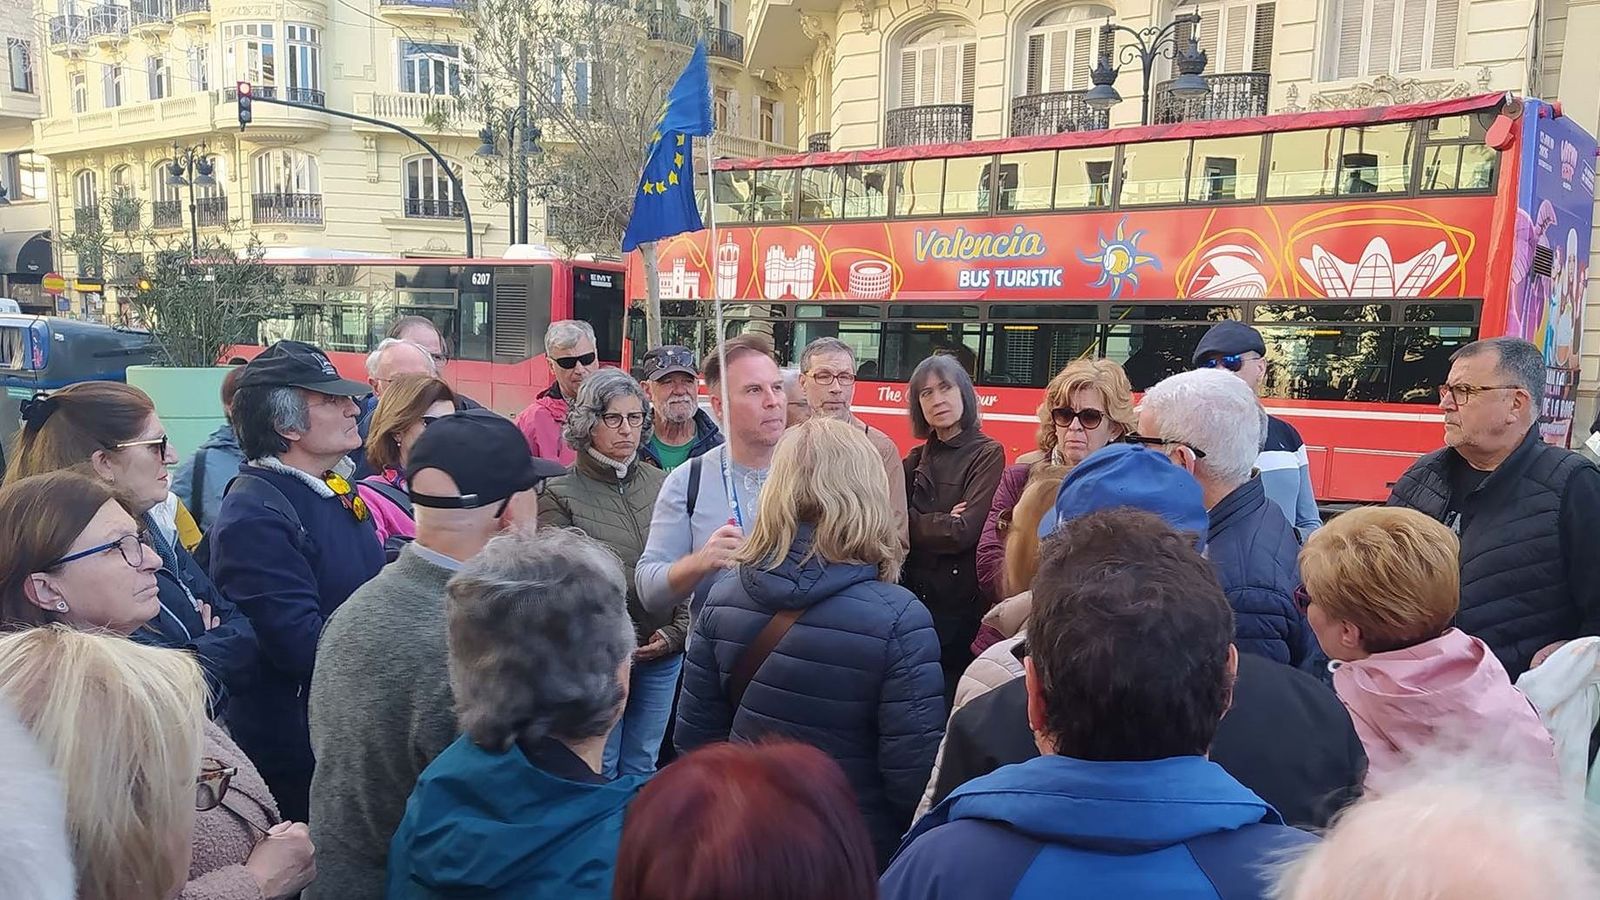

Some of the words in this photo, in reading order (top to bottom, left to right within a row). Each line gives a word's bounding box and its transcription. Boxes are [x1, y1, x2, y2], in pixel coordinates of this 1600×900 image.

[914, 225, 1046, 262] Valencia
[472, 273, 491, 285] 6207
[590, 273, 612, 282] EMT
[959, 270, 990, 287] BUS
[995, 269, 1063, 287] TURISTIC
[878, 386, 902, 401] The
